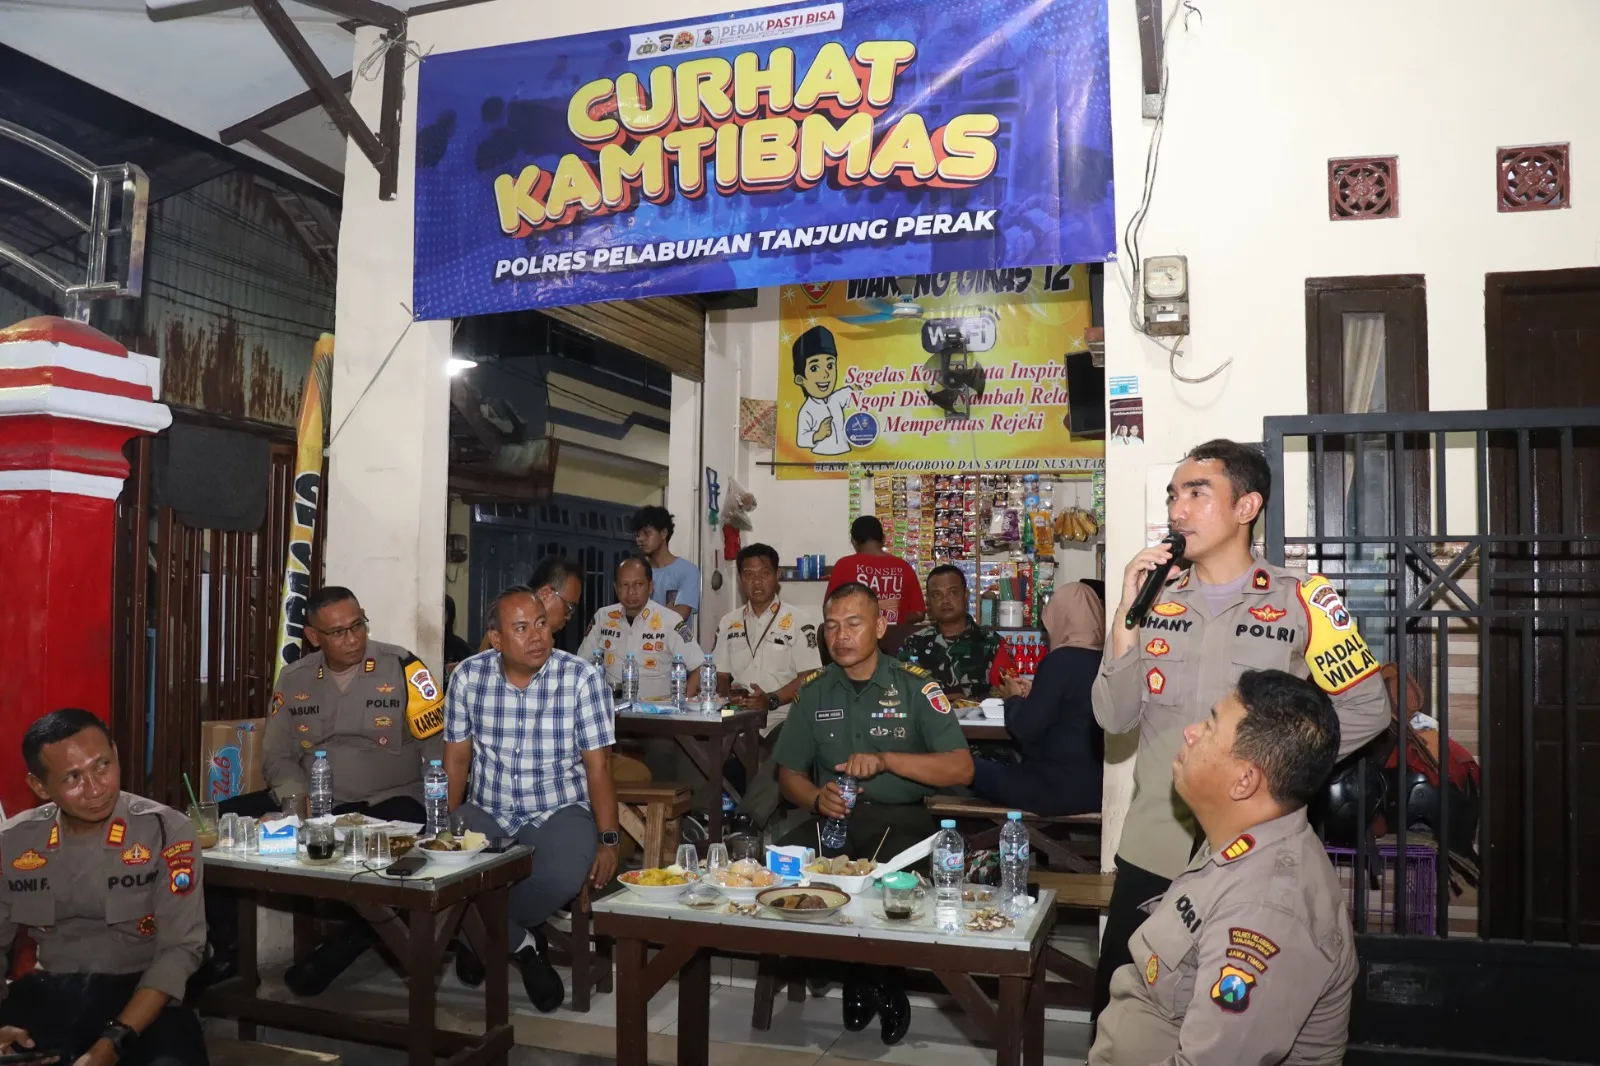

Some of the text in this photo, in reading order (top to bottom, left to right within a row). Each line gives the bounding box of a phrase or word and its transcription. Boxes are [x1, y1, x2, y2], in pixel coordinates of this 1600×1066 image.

[721, 20, 764, 38] PERAK
[766, 14, 803, 31] PASTI
[805, 9, 836, 26] BISA
[567, 40, 917, 143] CURHAT
[493, 111, 1000, 235] KAMTIBMAS
[495, 209, 998, 279] POLRES PELABUHAN TANJUNG PERAK
[847, 273, 951, 299] WARNG
[845, 366, 905, 387] Segelas
[910, 365, 941, 386] Kop
[848, 391, 895, 412] Ngopi
[990, 413, 1044, 435] Rejeki
[893, 460, 955, 471] JOGOBOYO
[957, 459, 981, 470] DAN
[984, 459, 1040, 470] SAPULIDI
[856, 573, 903, 593] SATU
[1235, 624, 1296, 643] POLRI
[1314, 634, 1363, 672] PADAL
[366, 699, 400, 709] POLRI
